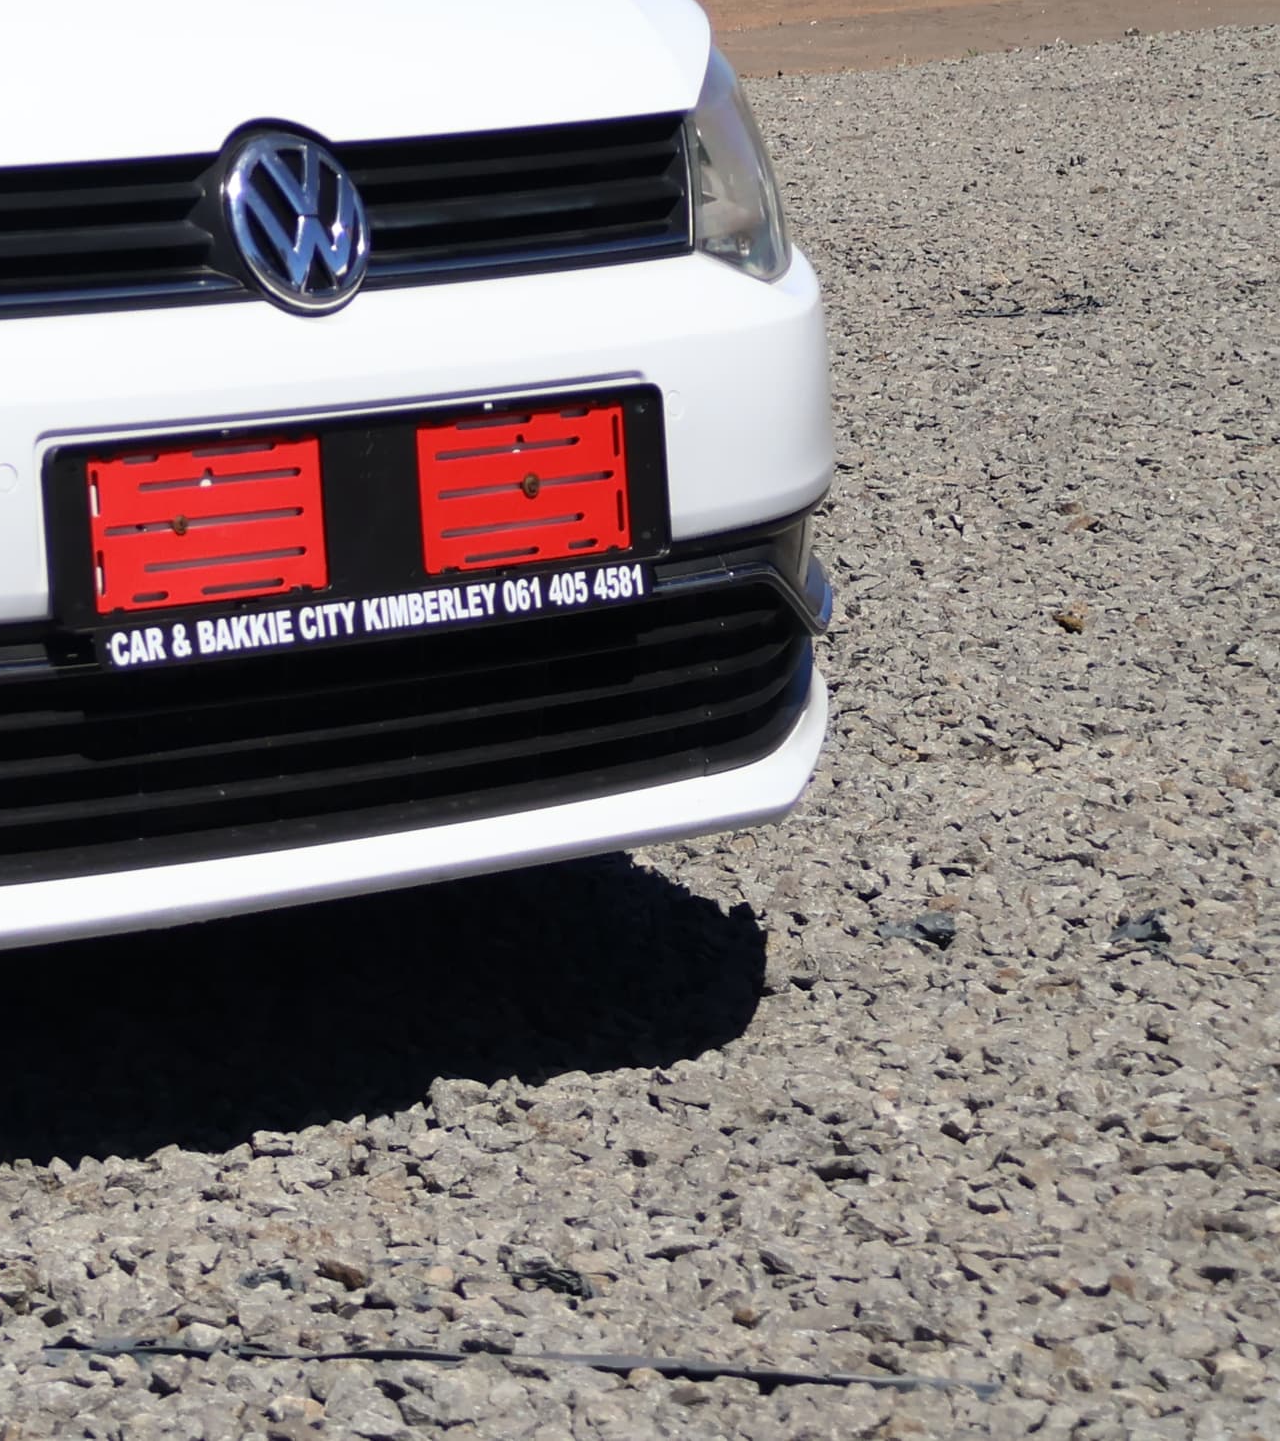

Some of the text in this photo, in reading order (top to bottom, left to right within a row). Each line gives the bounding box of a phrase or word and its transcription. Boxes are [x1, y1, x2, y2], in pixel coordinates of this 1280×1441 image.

[111, 564, 644, 667] CAR & BAKKIE CITY KIMBERLEY 061 405 4581
